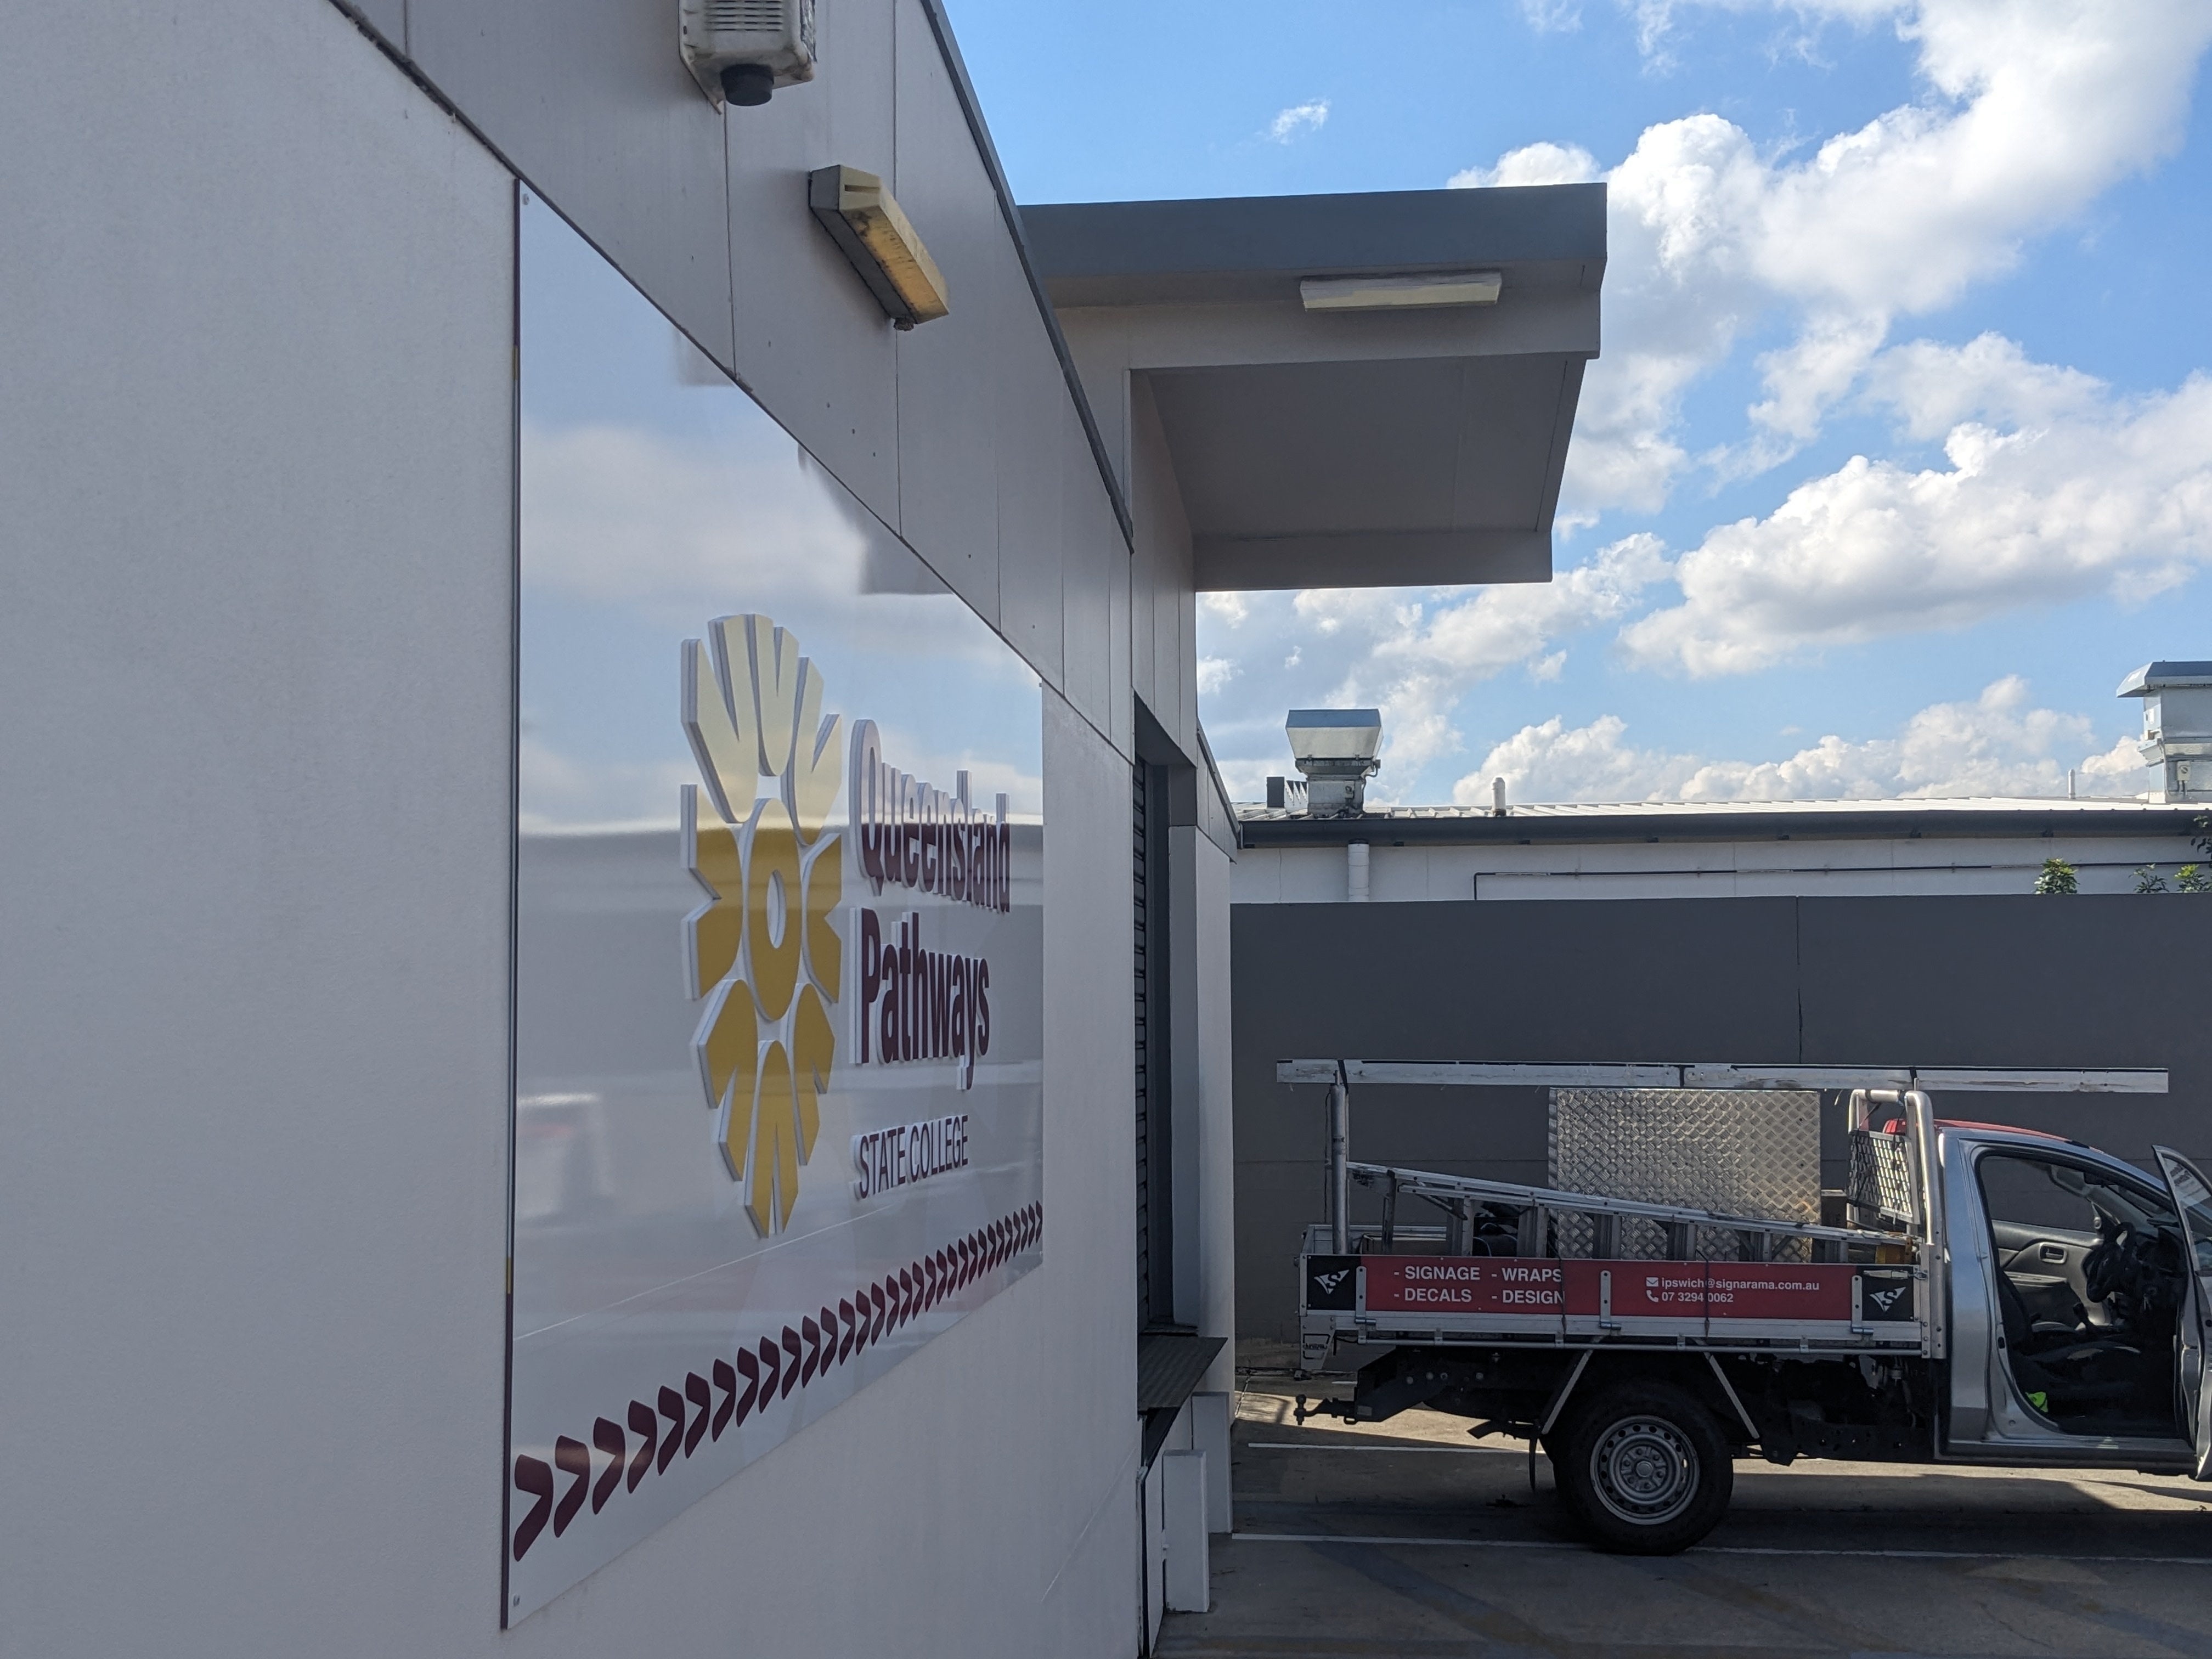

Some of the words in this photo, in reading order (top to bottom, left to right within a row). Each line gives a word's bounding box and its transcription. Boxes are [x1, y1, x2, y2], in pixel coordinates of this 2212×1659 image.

[850, 719, 1011, 913] Queensland
[850, 907, 990, 1090] Pathways
[854, 1126, 906, 1200] STATE
[908, 1115, 968, 1183] COLLEGE
[1404, 1266, 1480, 1280] SIGNAGE
[1502, 1268, 1562, 1283] WRAPS
[1661, 1277, 1820, 1291] ipswich@signarama.com.au
[1404, 1288, 1472, 1302] DECALS
[1502, 1290, 1565, 1305] DESIGN
[1661, 1291, 1675, 1302] 07
[1678, 1292, 1704, 1302] 3294
[1708, 1293, 1734, 1303] 0062
